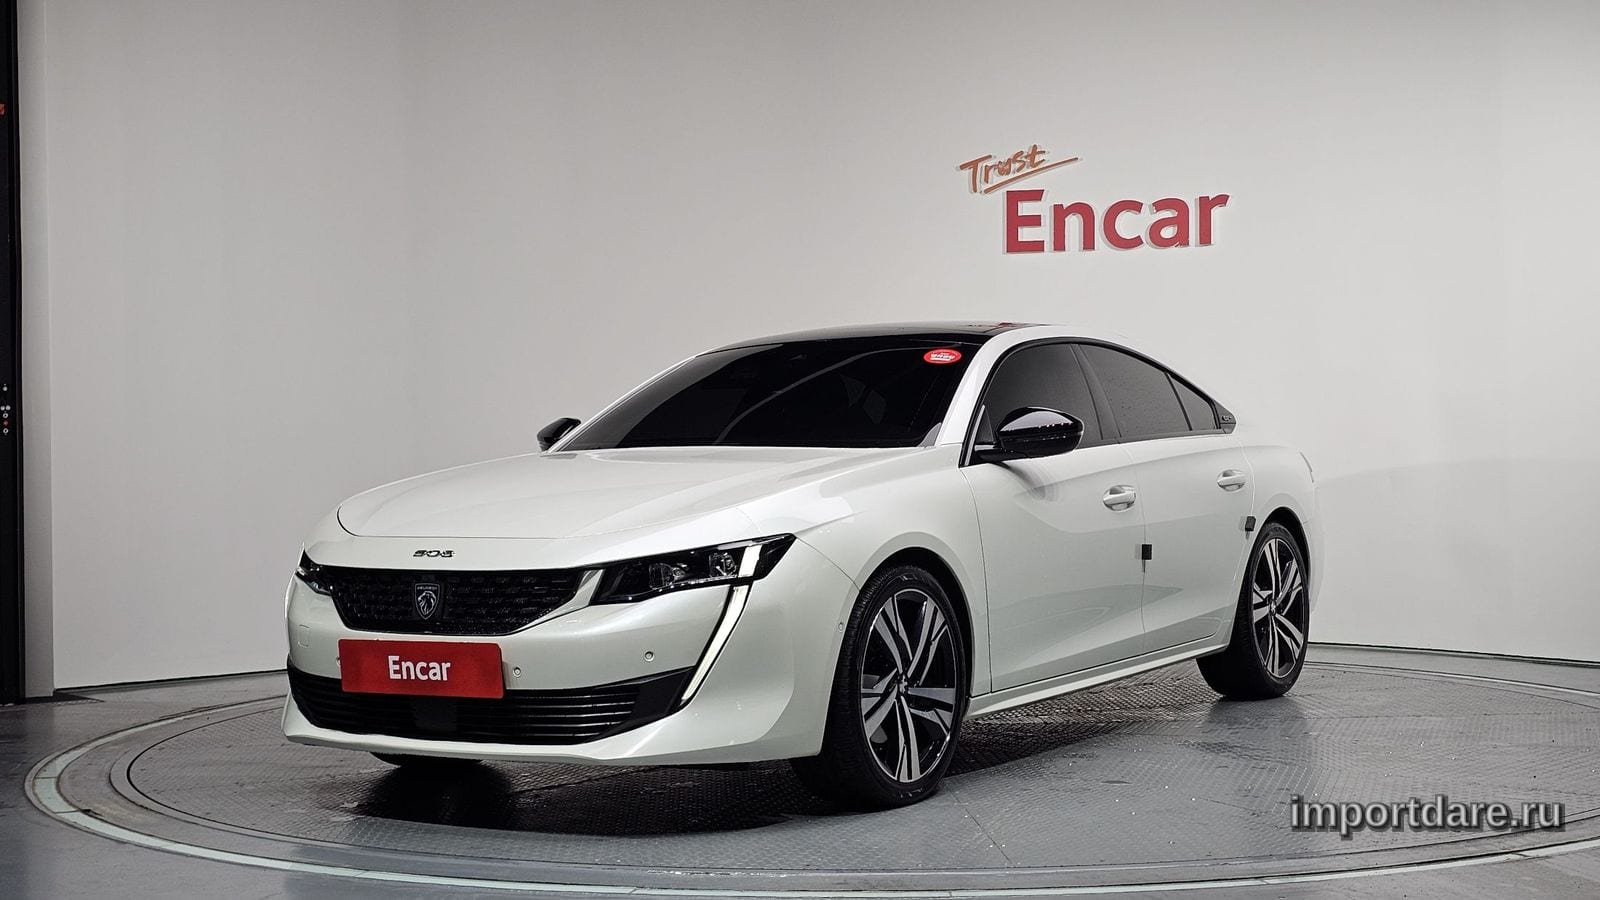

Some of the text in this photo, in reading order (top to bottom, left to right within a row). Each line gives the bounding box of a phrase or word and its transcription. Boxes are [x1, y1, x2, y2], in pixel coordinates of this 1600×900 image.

[959, 144, 1046, 193] Trust
[1006, 189, 1230, 253] Encar
[388, 655, 451, 681] Encar
